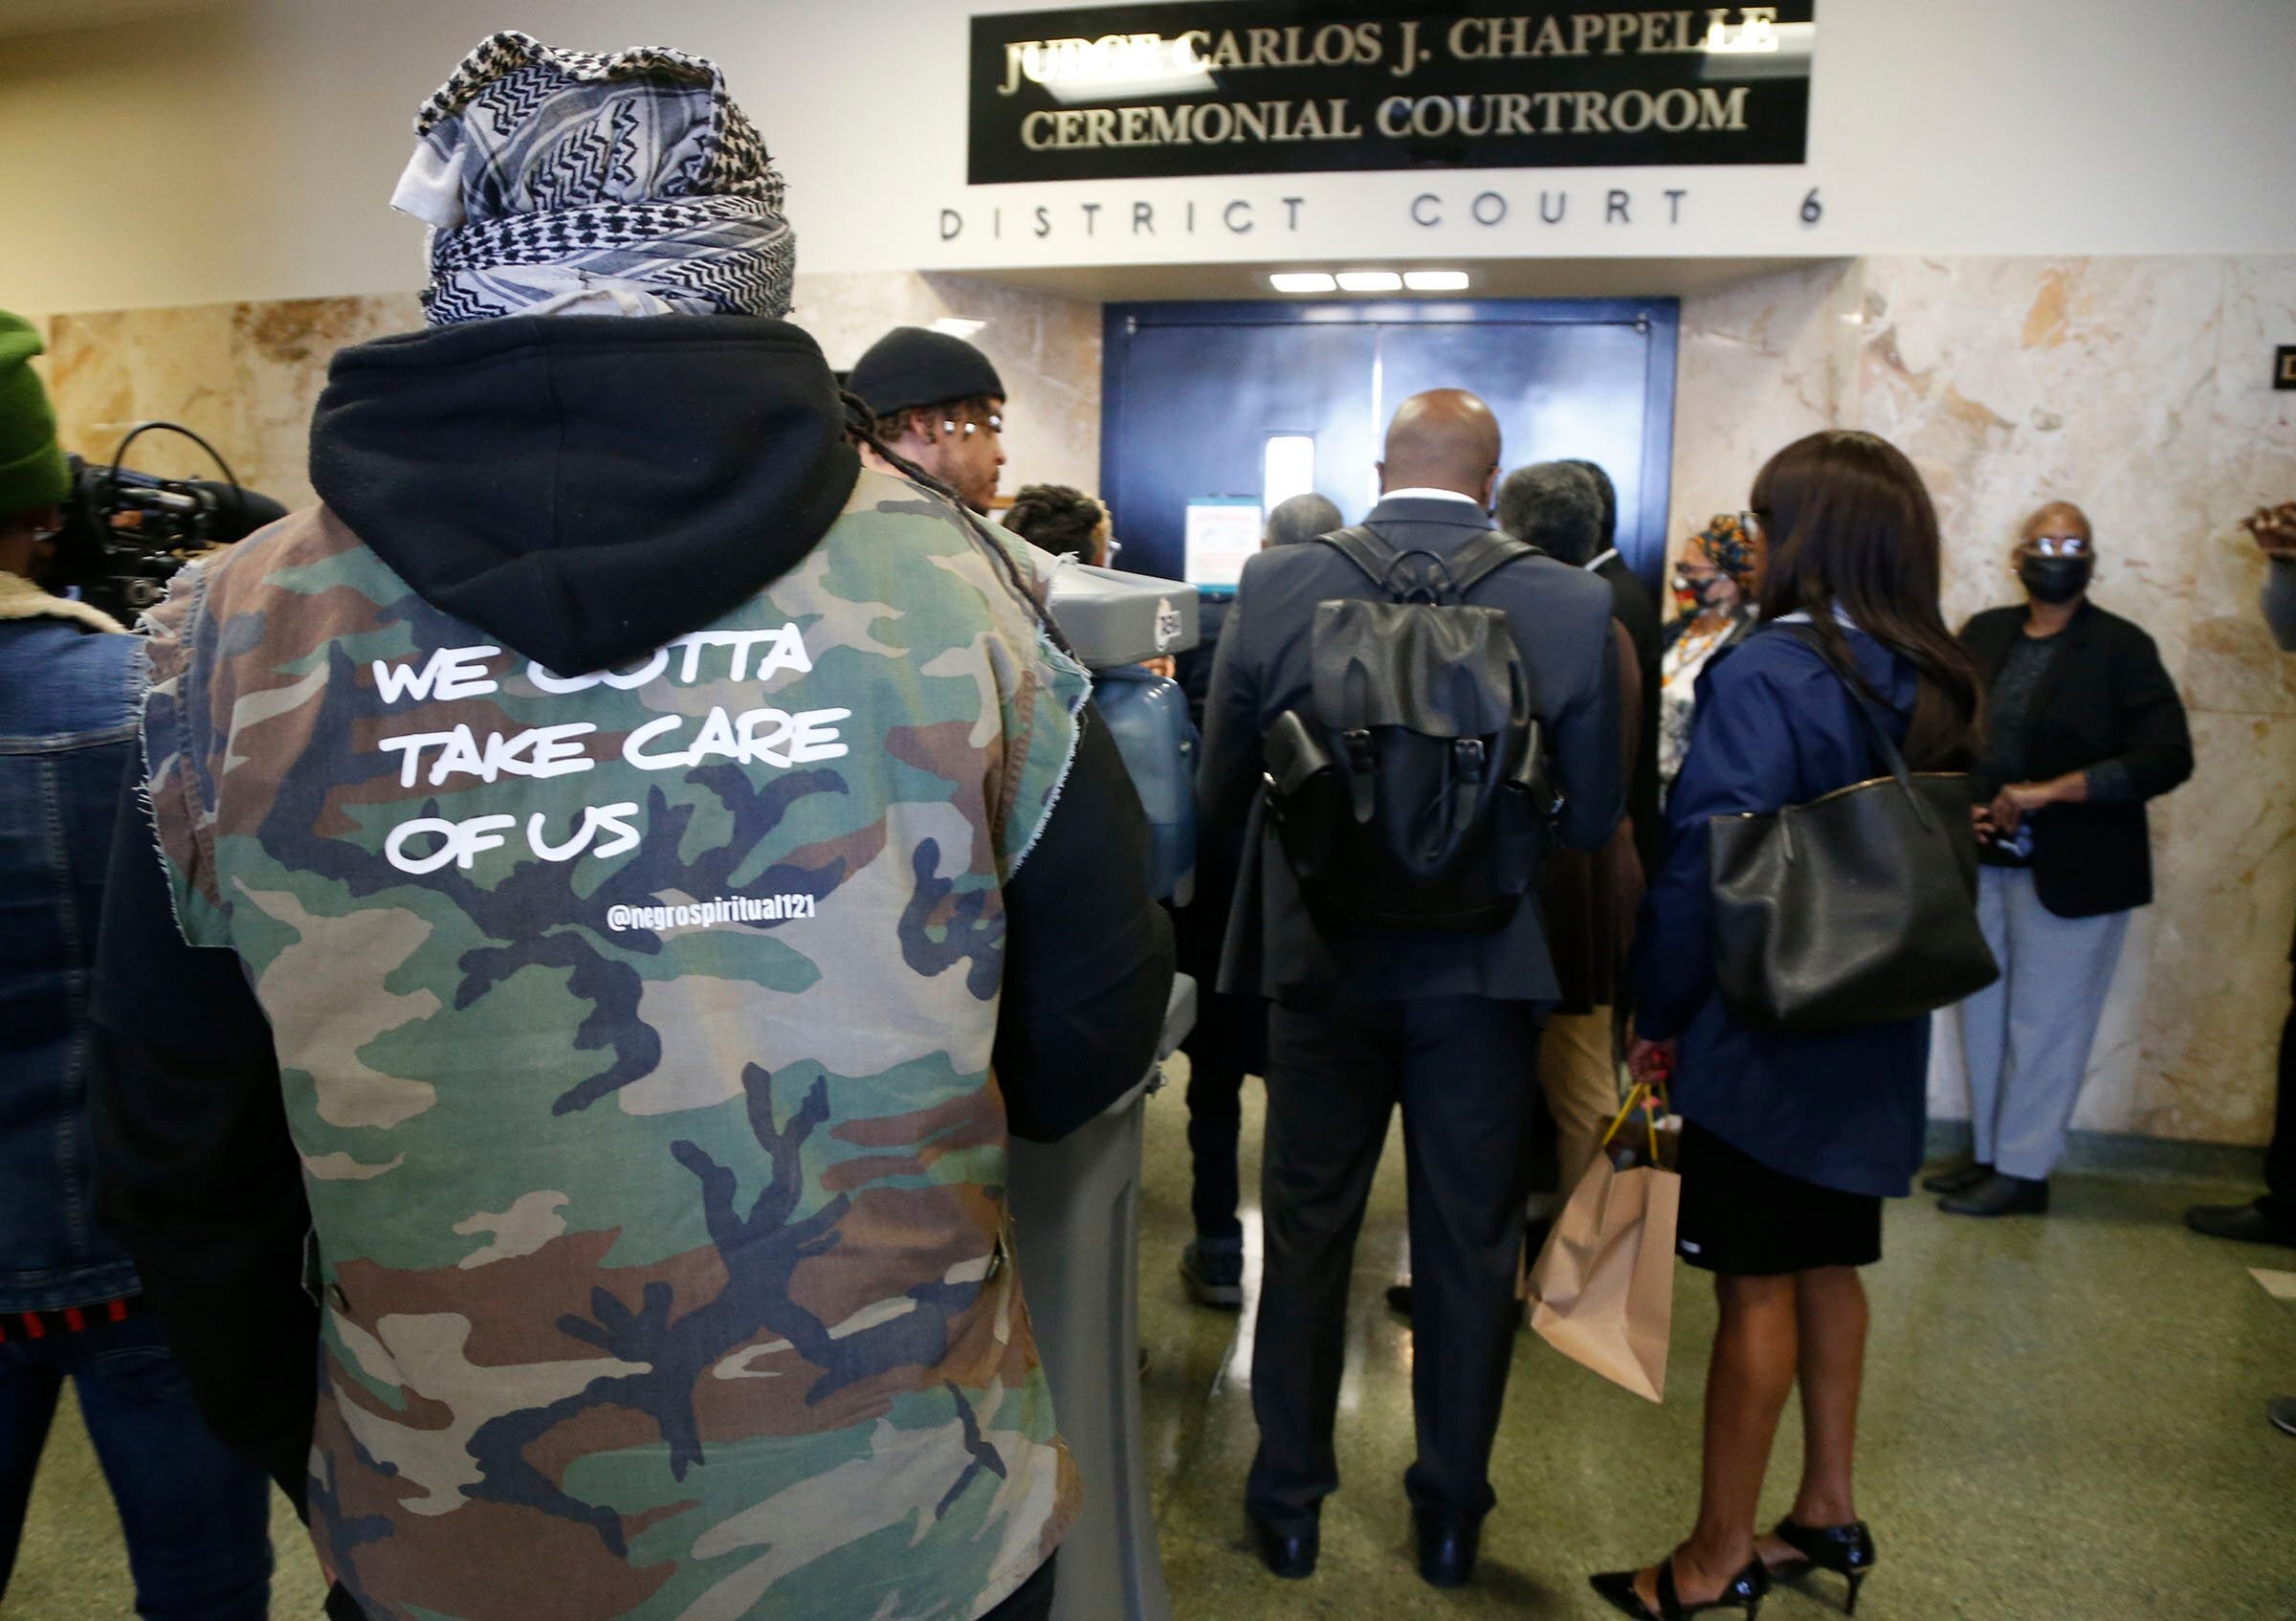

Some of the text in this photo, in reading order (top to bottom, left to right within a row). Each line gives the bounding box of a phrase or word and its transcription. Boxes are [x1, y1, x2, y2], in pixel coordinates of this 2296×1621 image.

[1172, 22, 1383, 71] CARLOS
[1391, 21, 1431, 77] J.
[1447, 7, 1779, 60] CHAPPELLE
[1021, 87, 1752, 151] CEREMONIAL COURTROOM
[939, 187, 1824, 241] DISTRICT COURT 6
[372, 645, 502, 704] WE
[378, 705, 852, 788] TAKE CARE
[384, 801, 642, 875] OF US
[607, 893, 817, 932] @negrospiritual121
